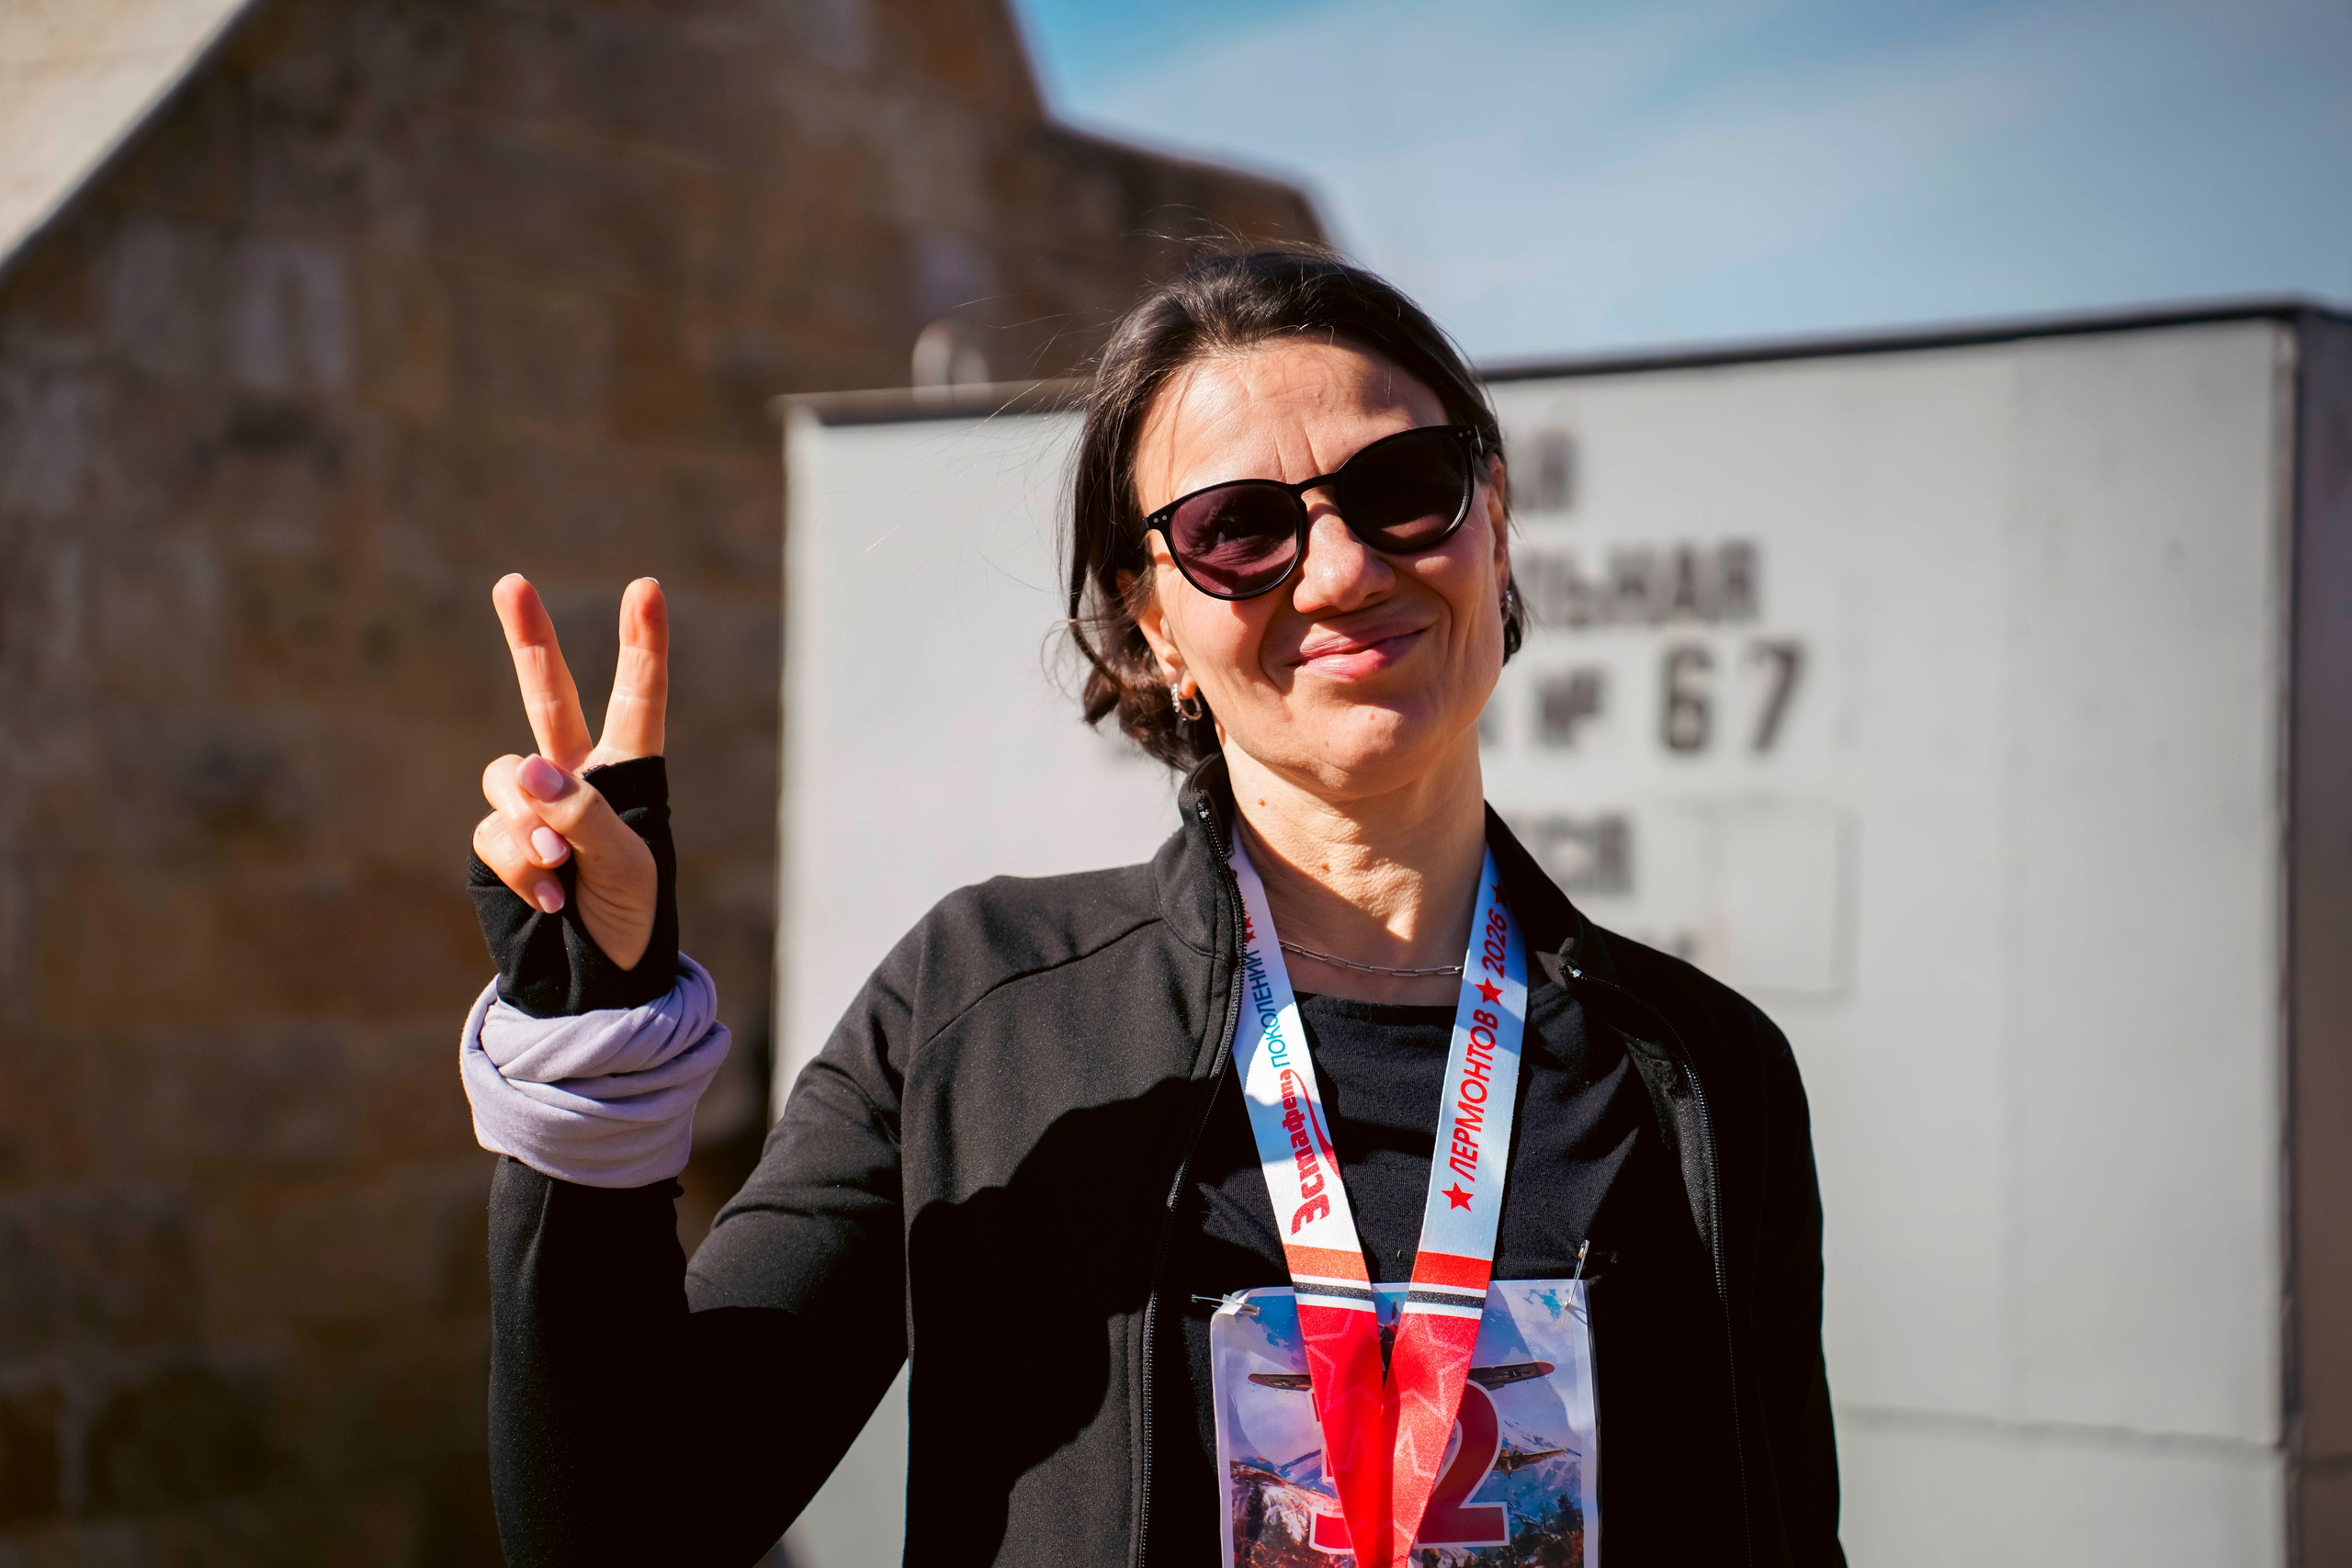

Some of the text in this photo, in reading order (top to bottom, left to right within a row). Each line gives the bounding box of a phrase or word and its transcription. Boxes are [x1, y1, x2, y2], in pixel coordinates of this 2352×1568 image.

[1280, 1068, 1330, 1235] Эстафета
[1449, 908, 1508, 1182] ЛЕРМОНТОВ 2026
